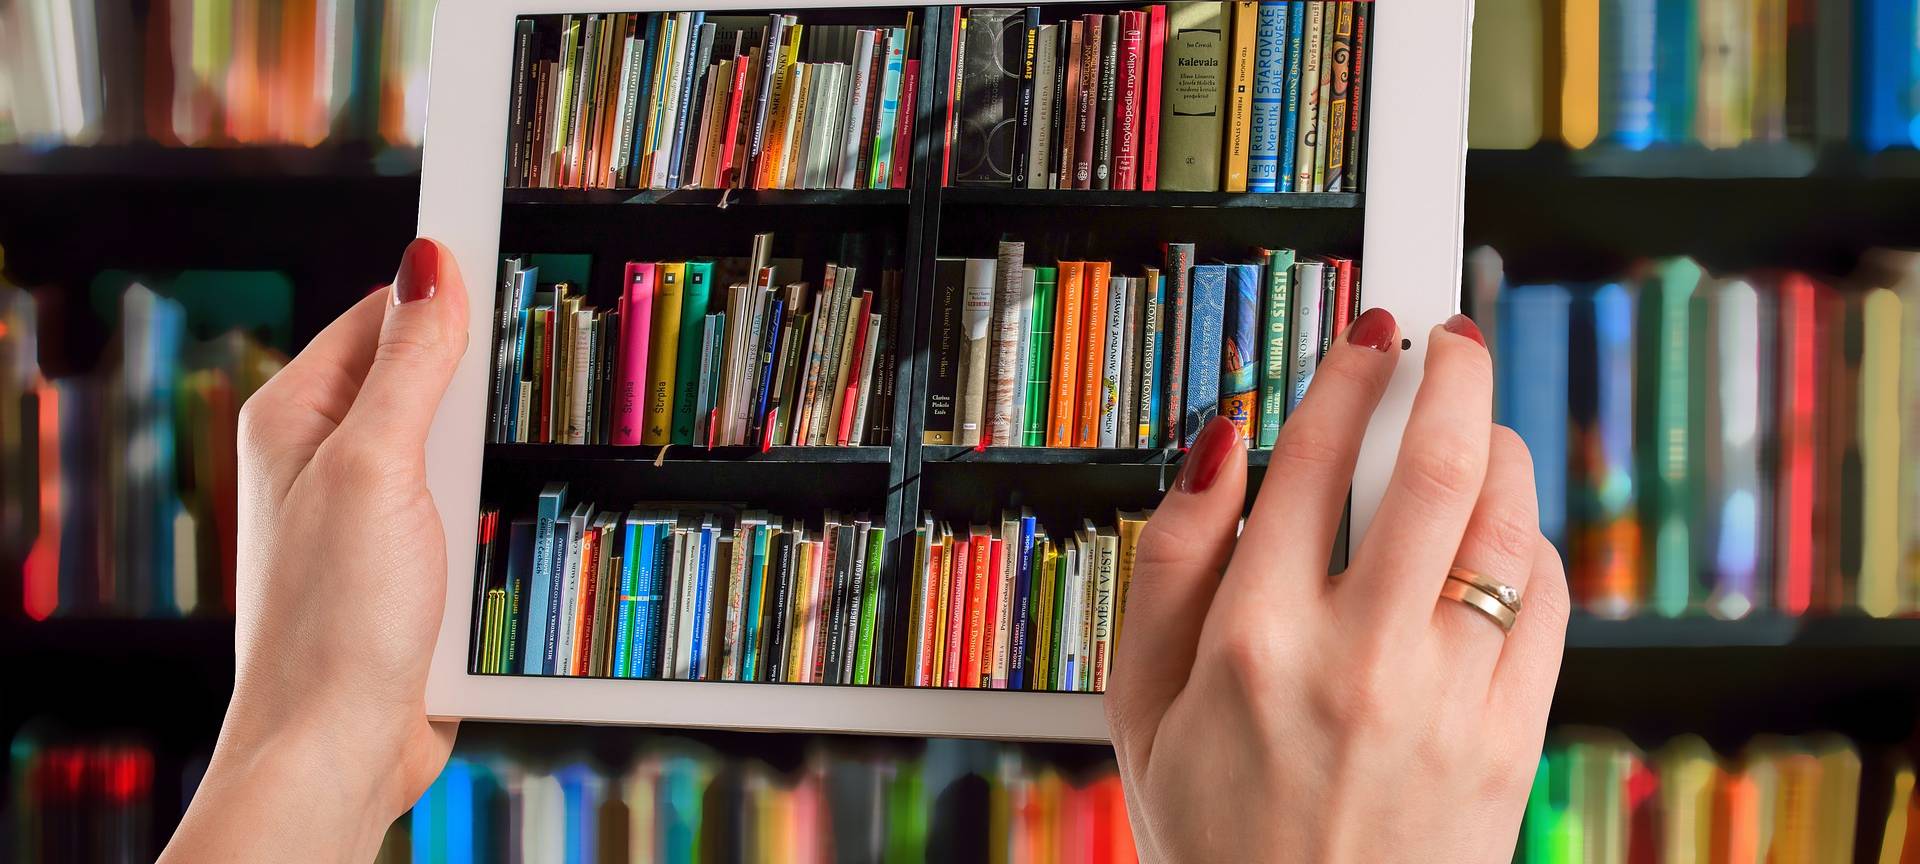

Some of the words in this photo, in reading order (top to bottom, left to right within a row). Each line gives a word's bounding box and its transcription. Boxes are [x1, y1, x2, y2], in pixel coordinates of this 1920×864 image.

[775, 53, 787, 90] MILENKY
[1110, 40, 1118, 74] mytologie
[1127, 52, 1137, 87] mystiky
[1178, 57, 1218, 66] Kalevala
[1101, 55, 1110, 100] Encyklopedie
[668, 82, 678, 112] Fernando
[771, 92, 780, 115] SMRT
[1122, 89, 1134, 152] Encyklopedie
[1252, 105, 1264, 151] Rudolf
[1251, 164, 1275, 177] argo
[1145, 297, 1155, 330] ŽIVOTA
[1272, 323, 1284, 333] O
[1145, 332, 1153, 367] OBSLUZE
[1268, 337, 1283, 379] KNIHA
[1298, 332, 1308, 367] GNOSE
[1098, 547, 1112, 584] VÉST
[849, 595, 858, 627] VIRGINIA
[1095, 588, 1108, 638] UMĚNÍ
